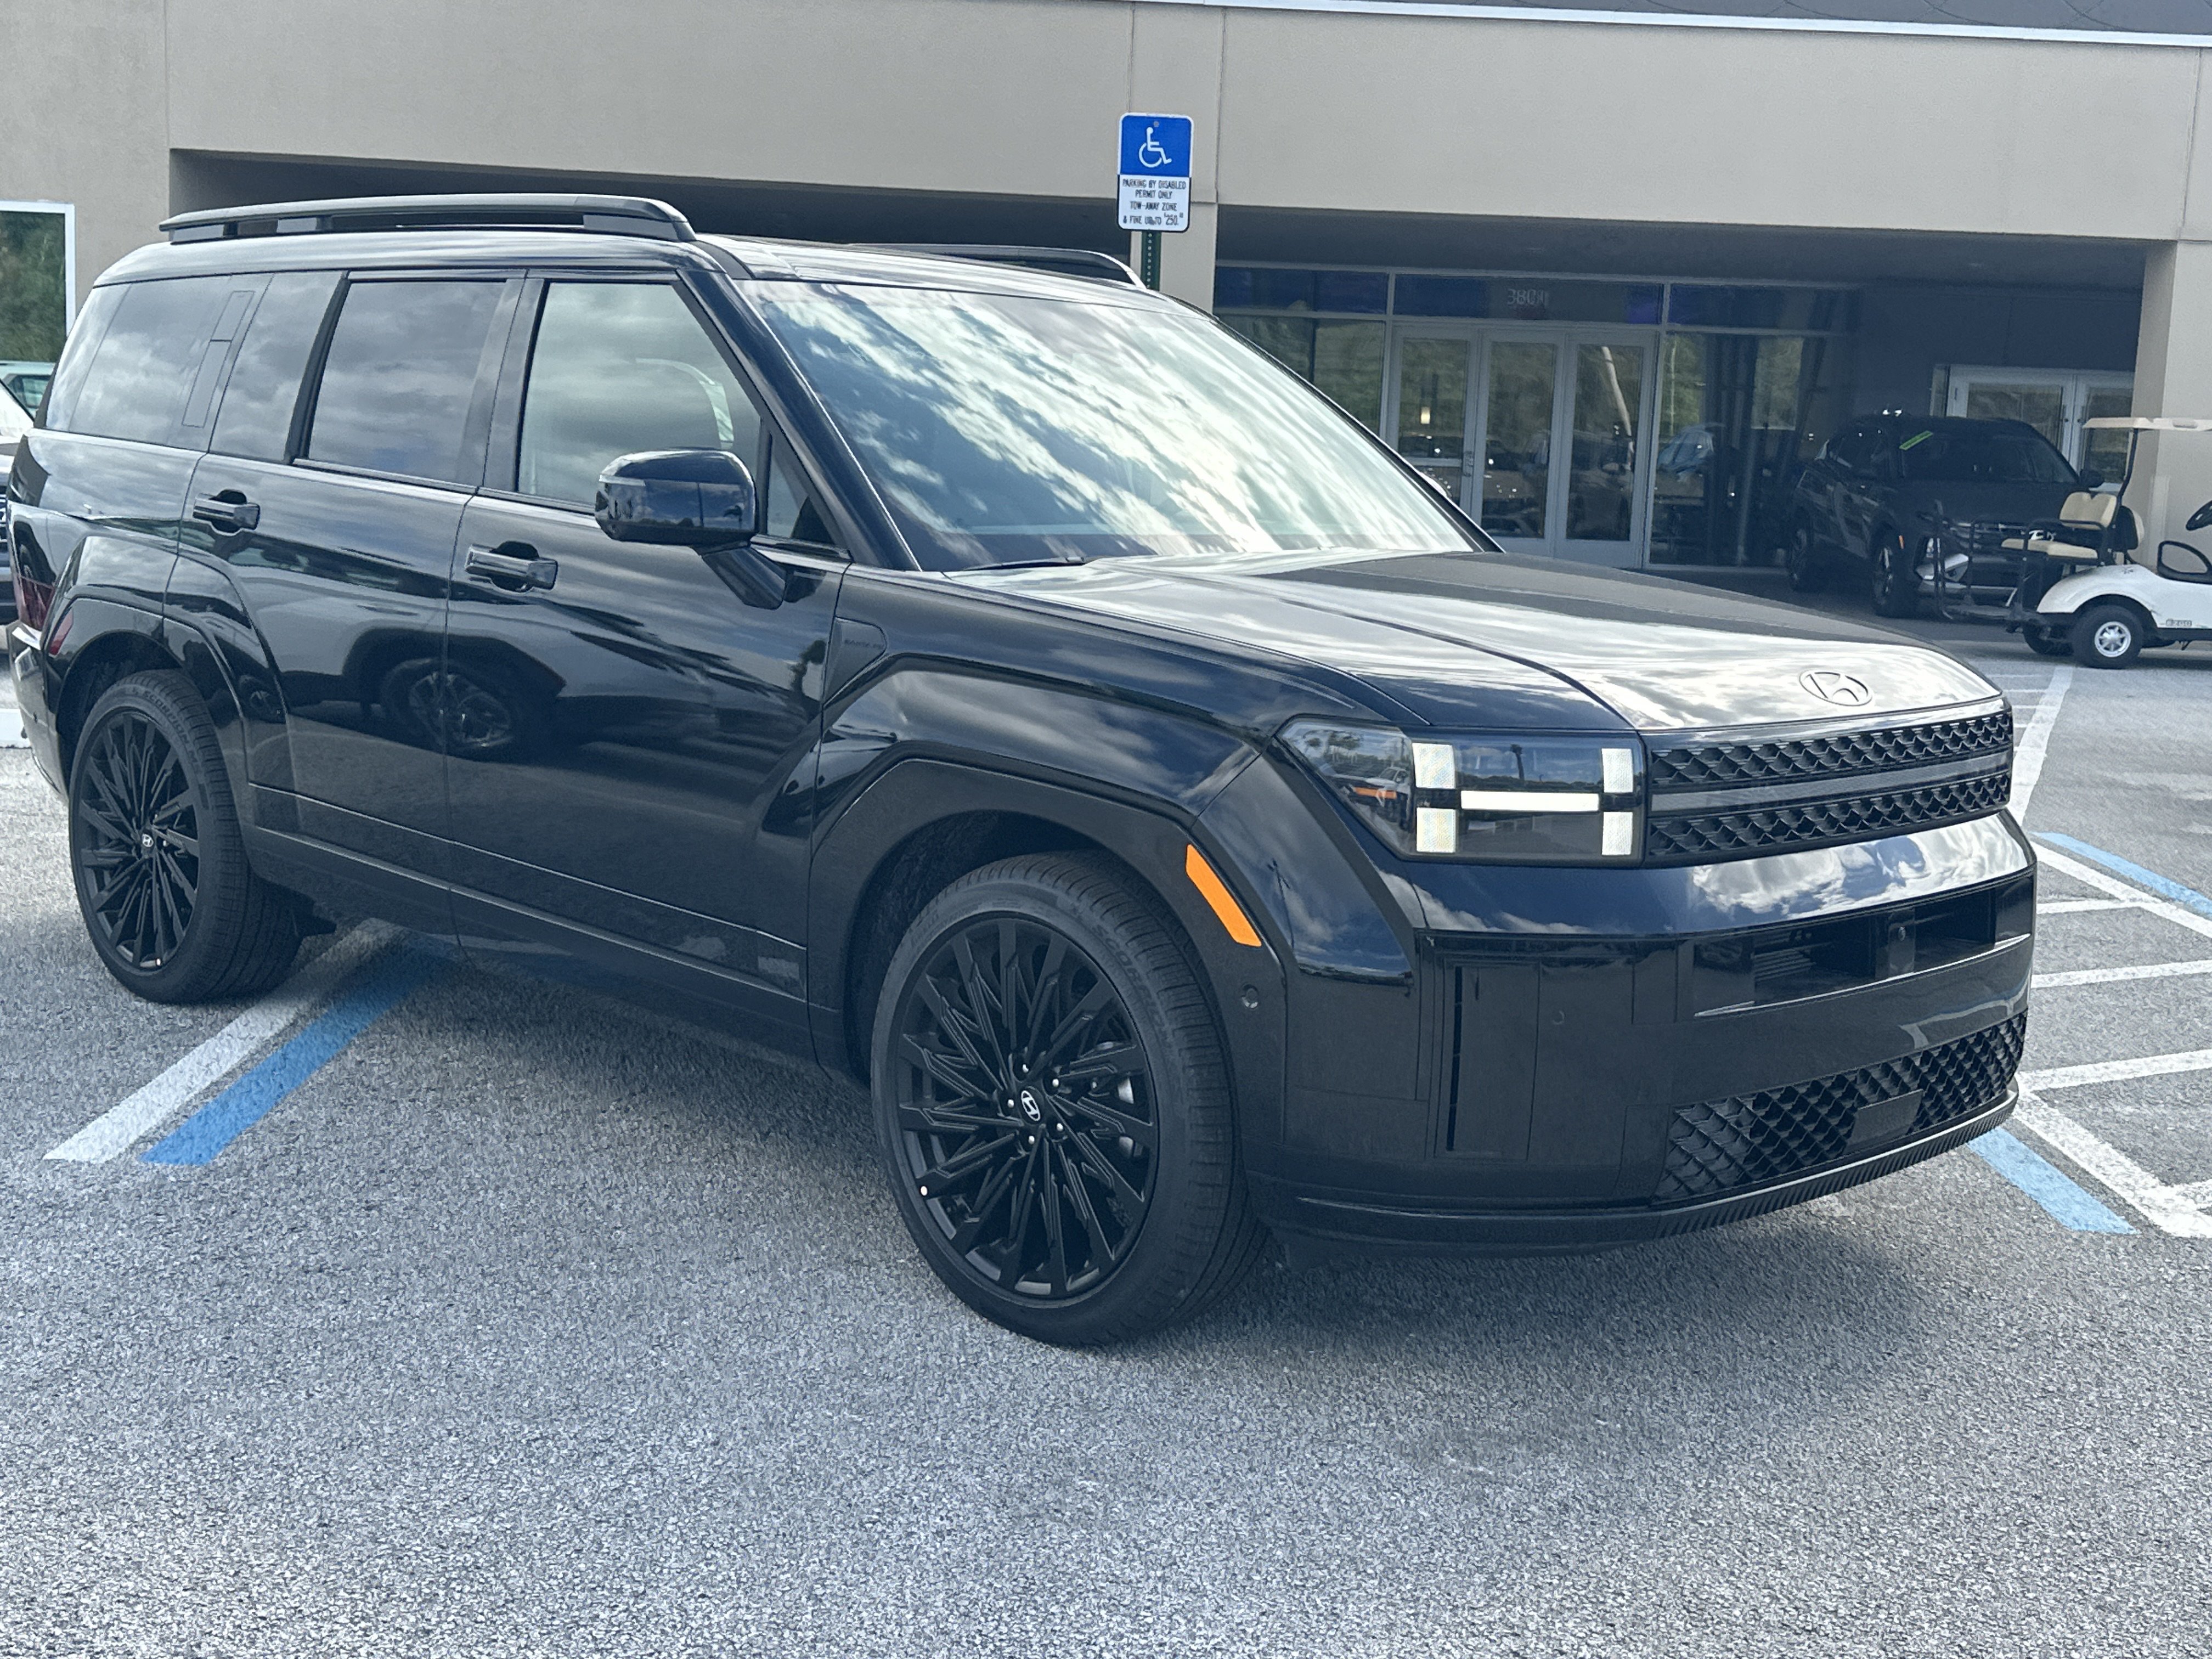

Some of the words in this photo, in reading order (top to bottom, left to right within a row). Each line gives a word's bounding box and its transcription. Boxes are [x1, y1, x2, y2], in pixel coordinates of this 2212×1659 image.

[1122, 179, 1147, 188] PARKING
[1158, 180, 1186, 189] DISABLED
[1135, 189, 1156, 198] PERMIT
[1158, 190, 1172, 199] ONLY
[1130, 201, 1160, 210] TOW-AWAY
[1162, 202, 1177, 211] ZONE
[1130, 216, 1142, 224] FINE
